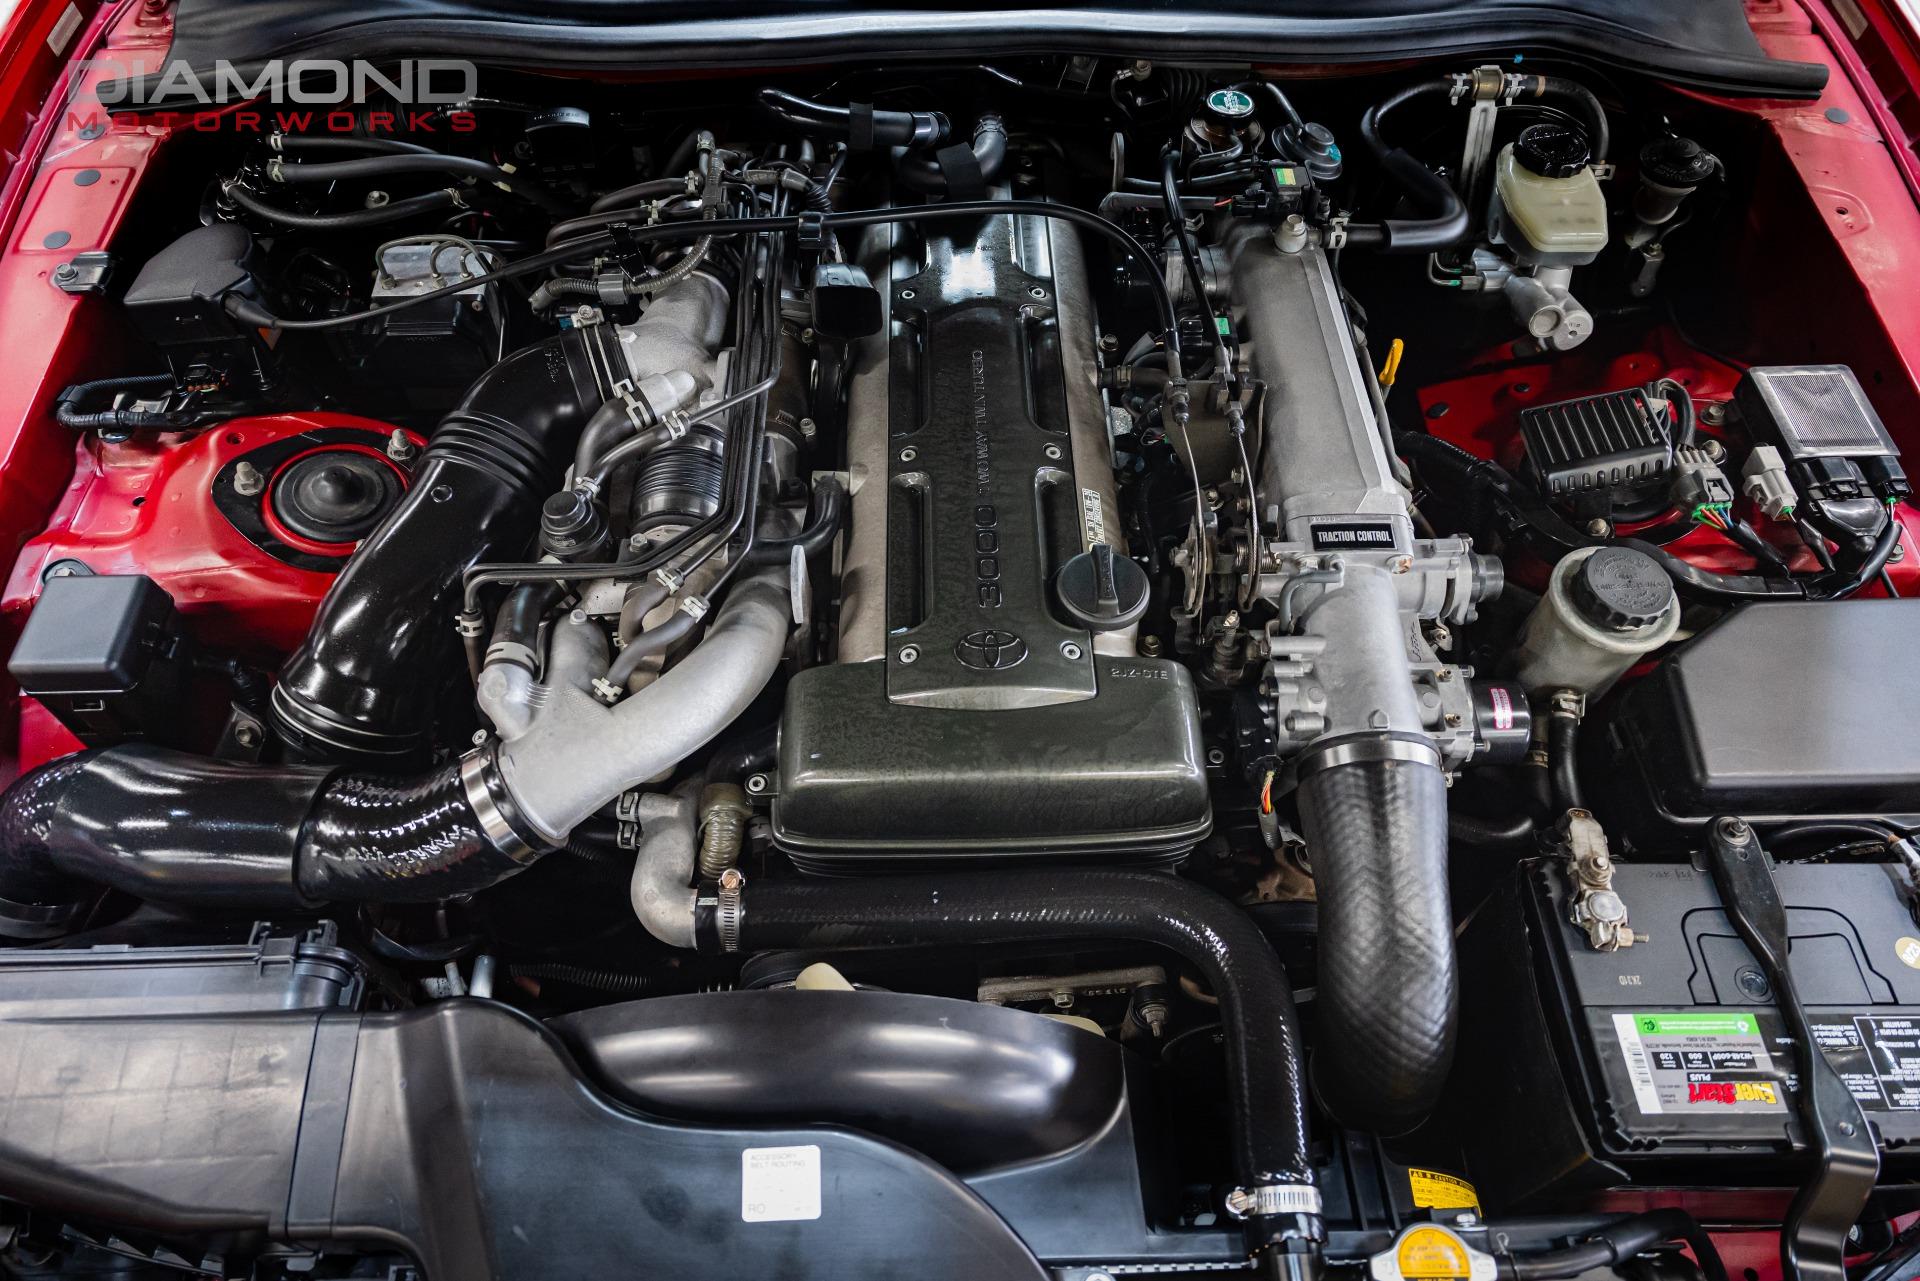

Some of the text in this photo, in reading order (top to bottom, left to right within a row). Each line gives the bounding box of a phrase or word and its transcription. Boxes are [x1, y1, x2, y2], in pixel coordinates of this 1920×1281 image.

[971, 350, 985, 393] TURBO
[1317, 530, 1392, 542] TRACTION CONTROL
[976, 505, 1002, 608] 3000
[1690, 1073, 1711, 1081] PLUS
[1688, 1082, 1777, 1105] EverStart
